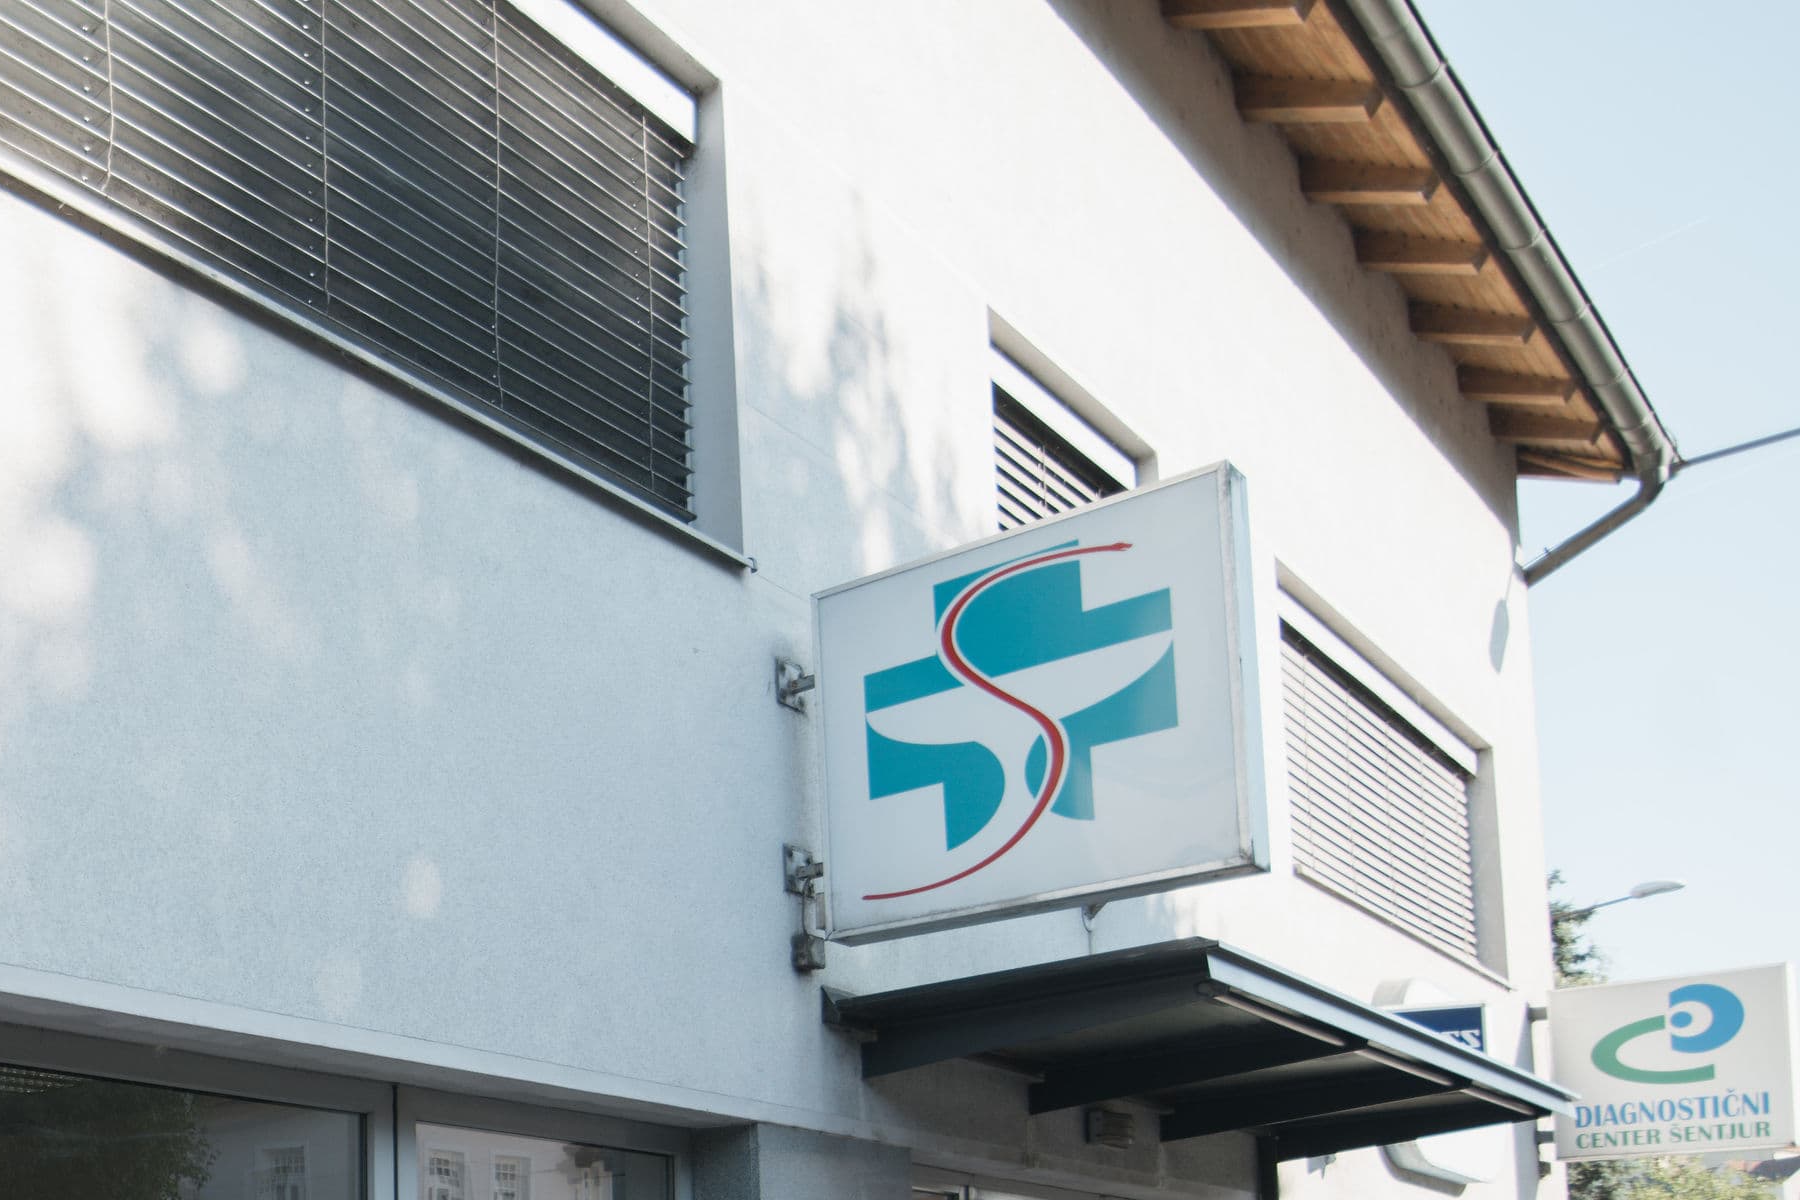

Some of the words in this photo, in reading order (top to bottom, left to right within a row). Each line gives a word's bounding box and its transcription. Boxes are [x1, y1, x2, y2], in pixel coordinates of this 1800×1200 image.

[1574, 1088, 1771, 1128] DIAGNOSTIČNI
[1575, 1128, 1661, 1149] CENTER
[1669, 1121, 1771, 1143] ŠENTJUR
